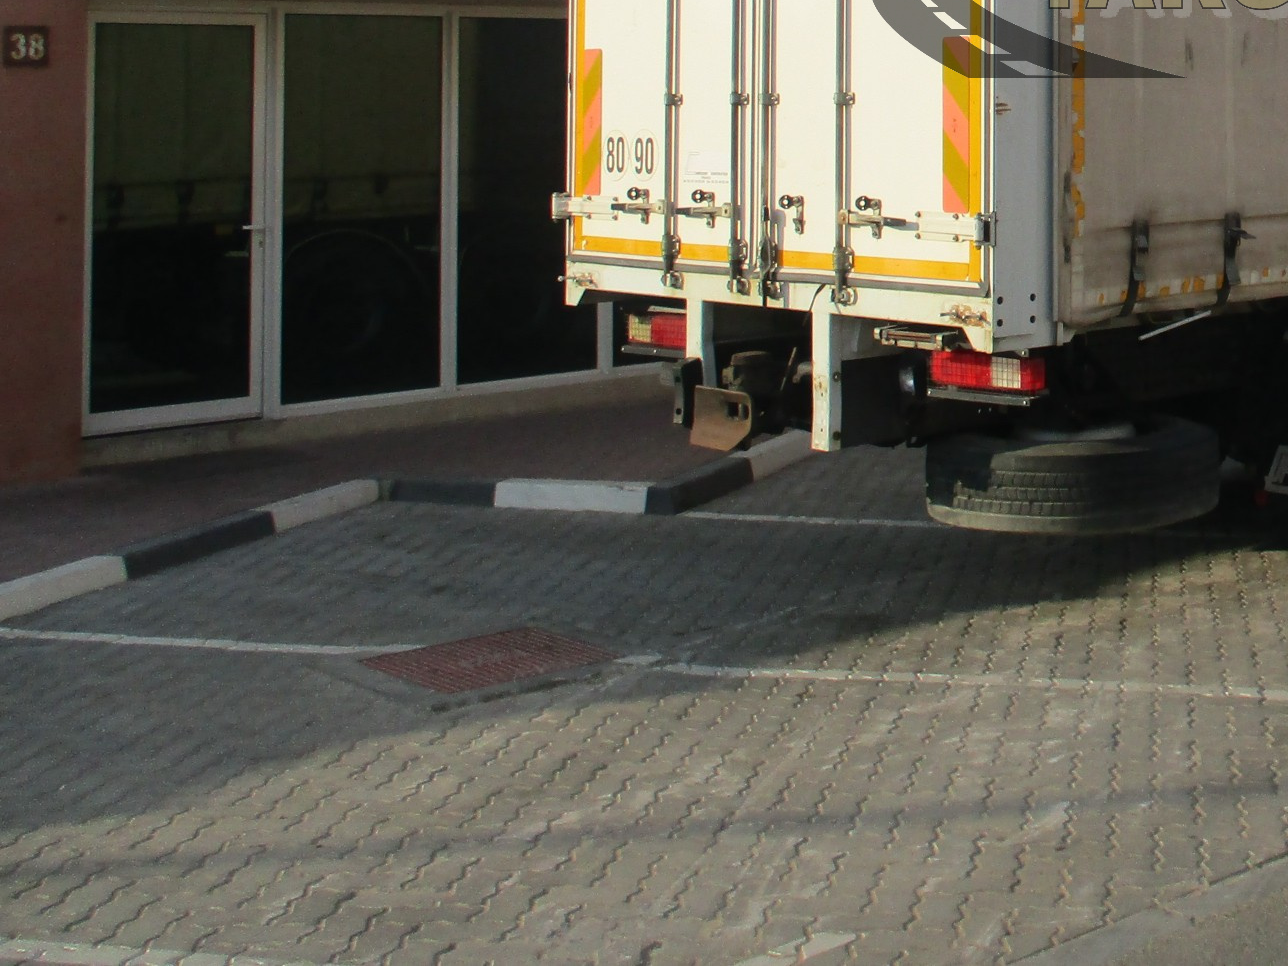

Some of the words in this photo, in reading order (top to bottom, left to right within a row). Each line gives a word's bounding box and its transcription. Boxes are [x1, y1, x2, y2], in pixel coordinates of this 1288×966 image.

[10, 33, 45, 61] 38
[606, 136, 625, 173] 80
[634, 137, 655, 175] 90
